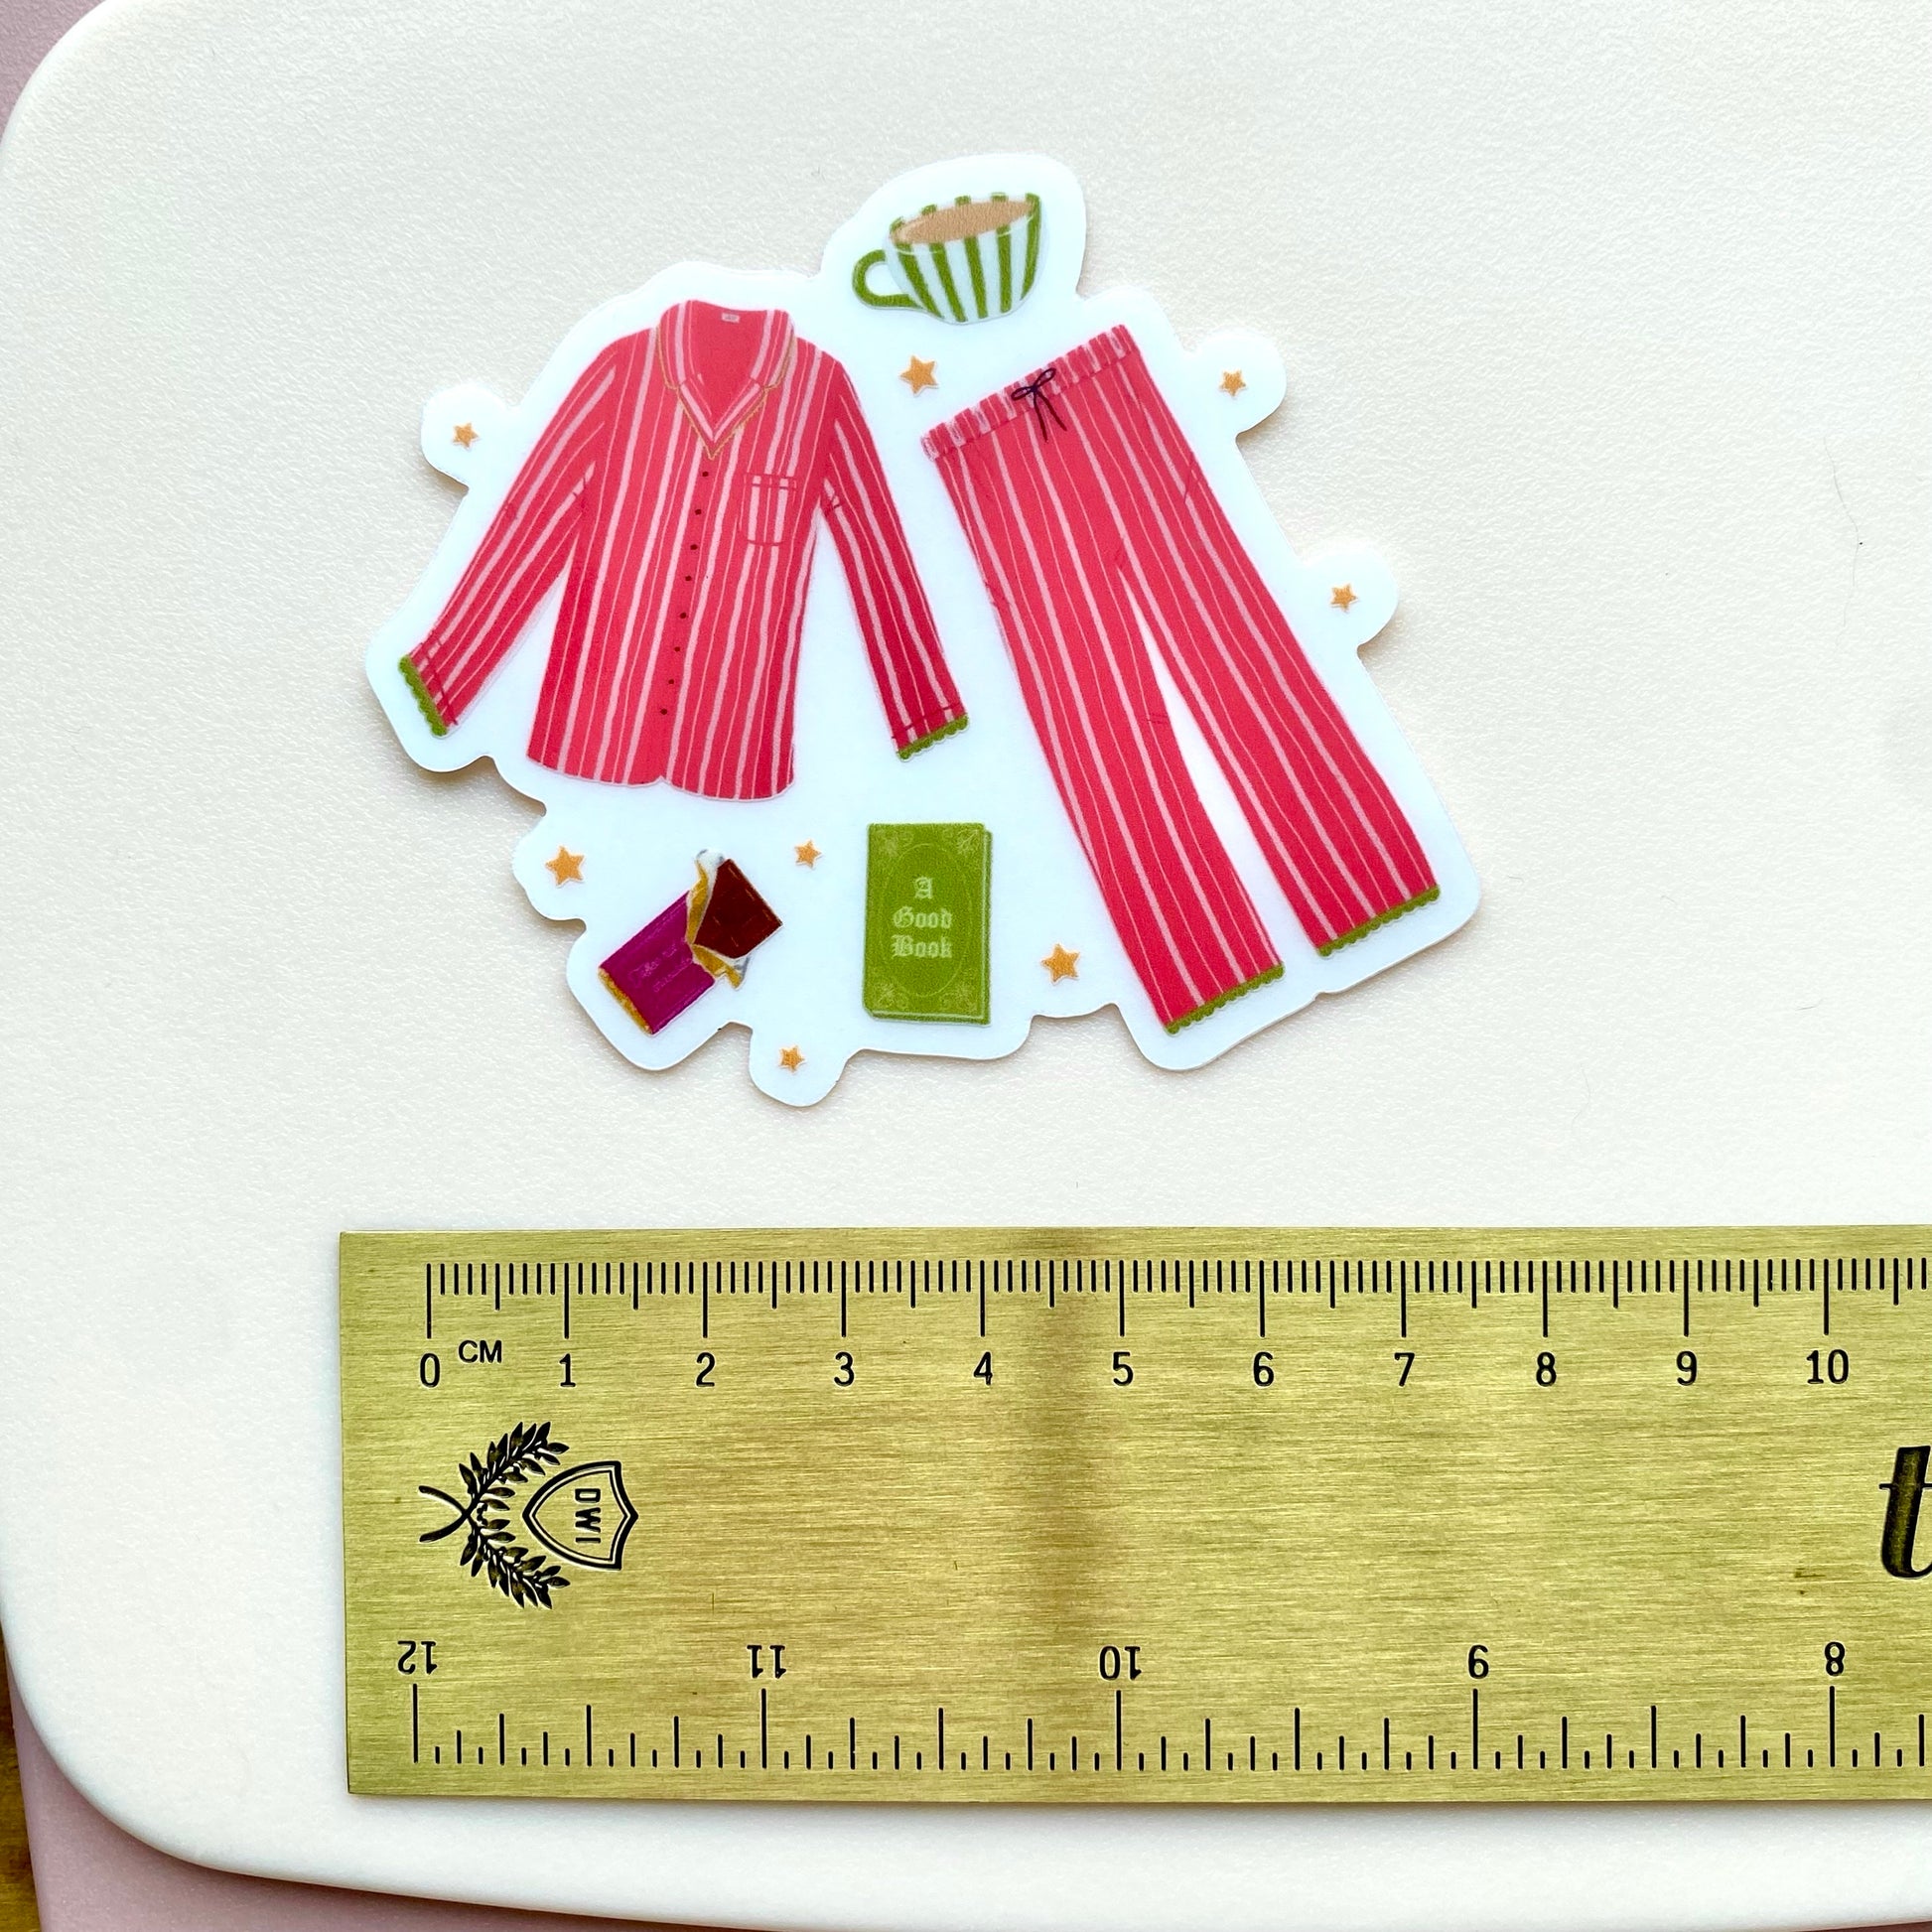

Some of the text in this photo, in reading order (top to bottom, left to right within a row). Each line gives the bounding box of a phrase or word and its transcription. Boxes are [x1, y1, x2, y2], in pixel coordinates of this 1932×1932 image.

[914, 876, 934, 900] A
[892, 904, 953, 930] Good
[891, 934, 953, 960] Book
[421, 1343, 1849, 1387] 0 CM 1 2 3 4 5 6 7 8 9 10
[574, 1487, 602, 1545] DWI
[398, 1640, 437, 1675] 12
[748, 1644, 787, 1678] 11
[1100, 1645, 1141, 1680] 10
[1825, 1641, 1845, 1677] 8
